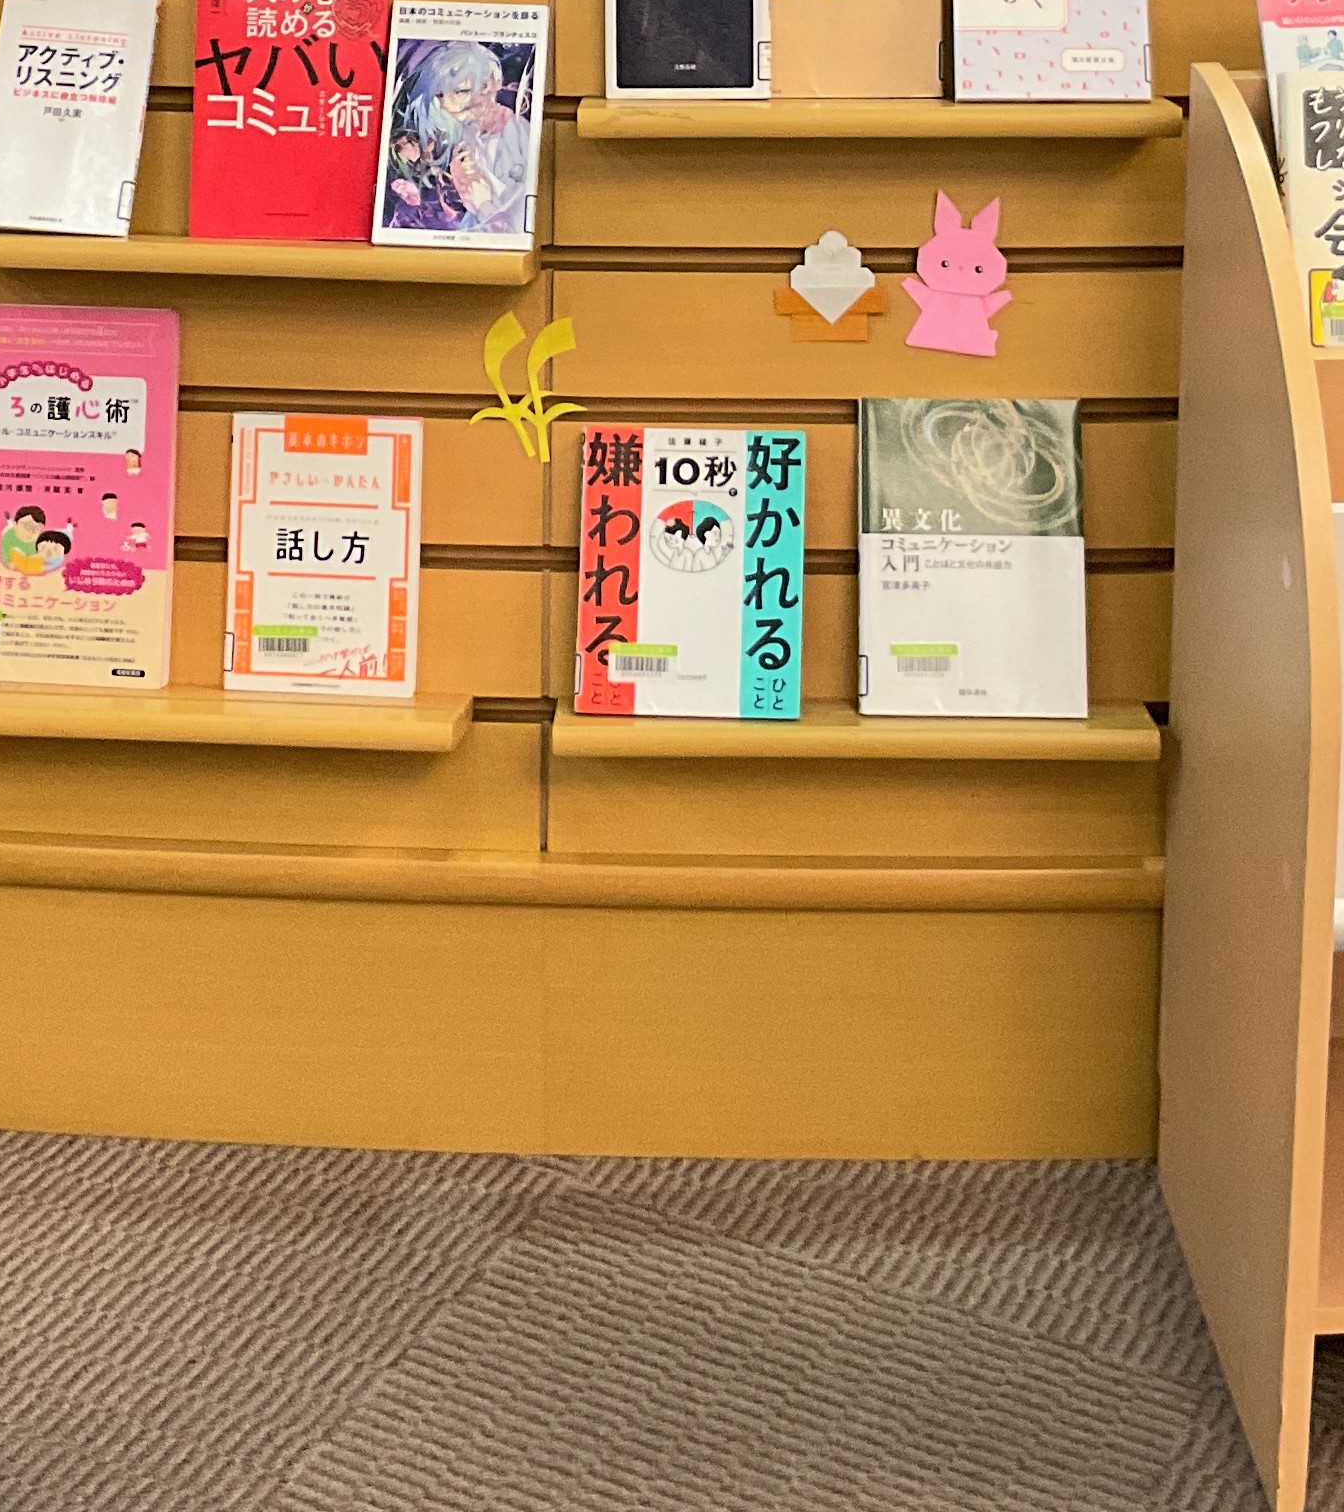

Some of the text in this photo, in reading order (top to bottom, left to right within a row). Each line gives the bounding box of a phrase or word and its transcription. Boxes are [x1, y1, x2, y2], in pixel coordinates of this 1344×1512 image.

[245, 7, 338, 38] 読める
[15, 64, 123, 94] リスニング
[195, 33, 388, 97] ヤバい
[654, 455, 738, 487] 10秒
[881, 506, 963, 533] 異文化
[276, 527, 371, 565] 話し方
[582, 431, 645, 668] 嫌われる
[743, 435, 802, 671] 好かれる
[880, 536, 1013, 554] コミュニケーション
[880, 554, 921, 573] 入門
[753, 676, 766, 710] こと
[771, 676, 787, 712] ひと
